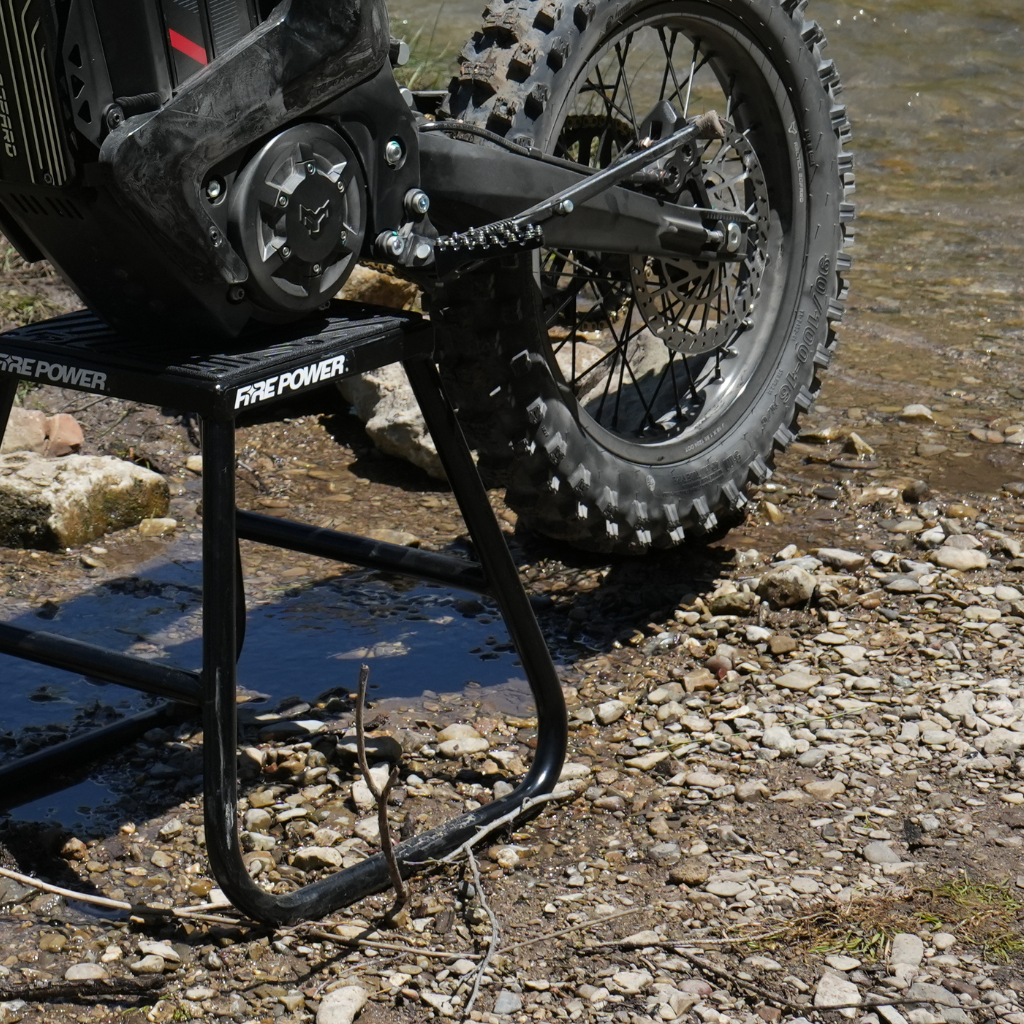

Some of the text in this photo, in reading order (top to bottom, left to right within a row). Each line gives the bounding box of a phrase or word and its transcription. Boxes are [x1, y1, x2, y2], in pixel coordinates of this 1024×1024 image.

[778, 254, 831, 404] 90/100-16
[35, 360, 107, 391] POWER
[234, 354, 345, 409] FIRE POWER
